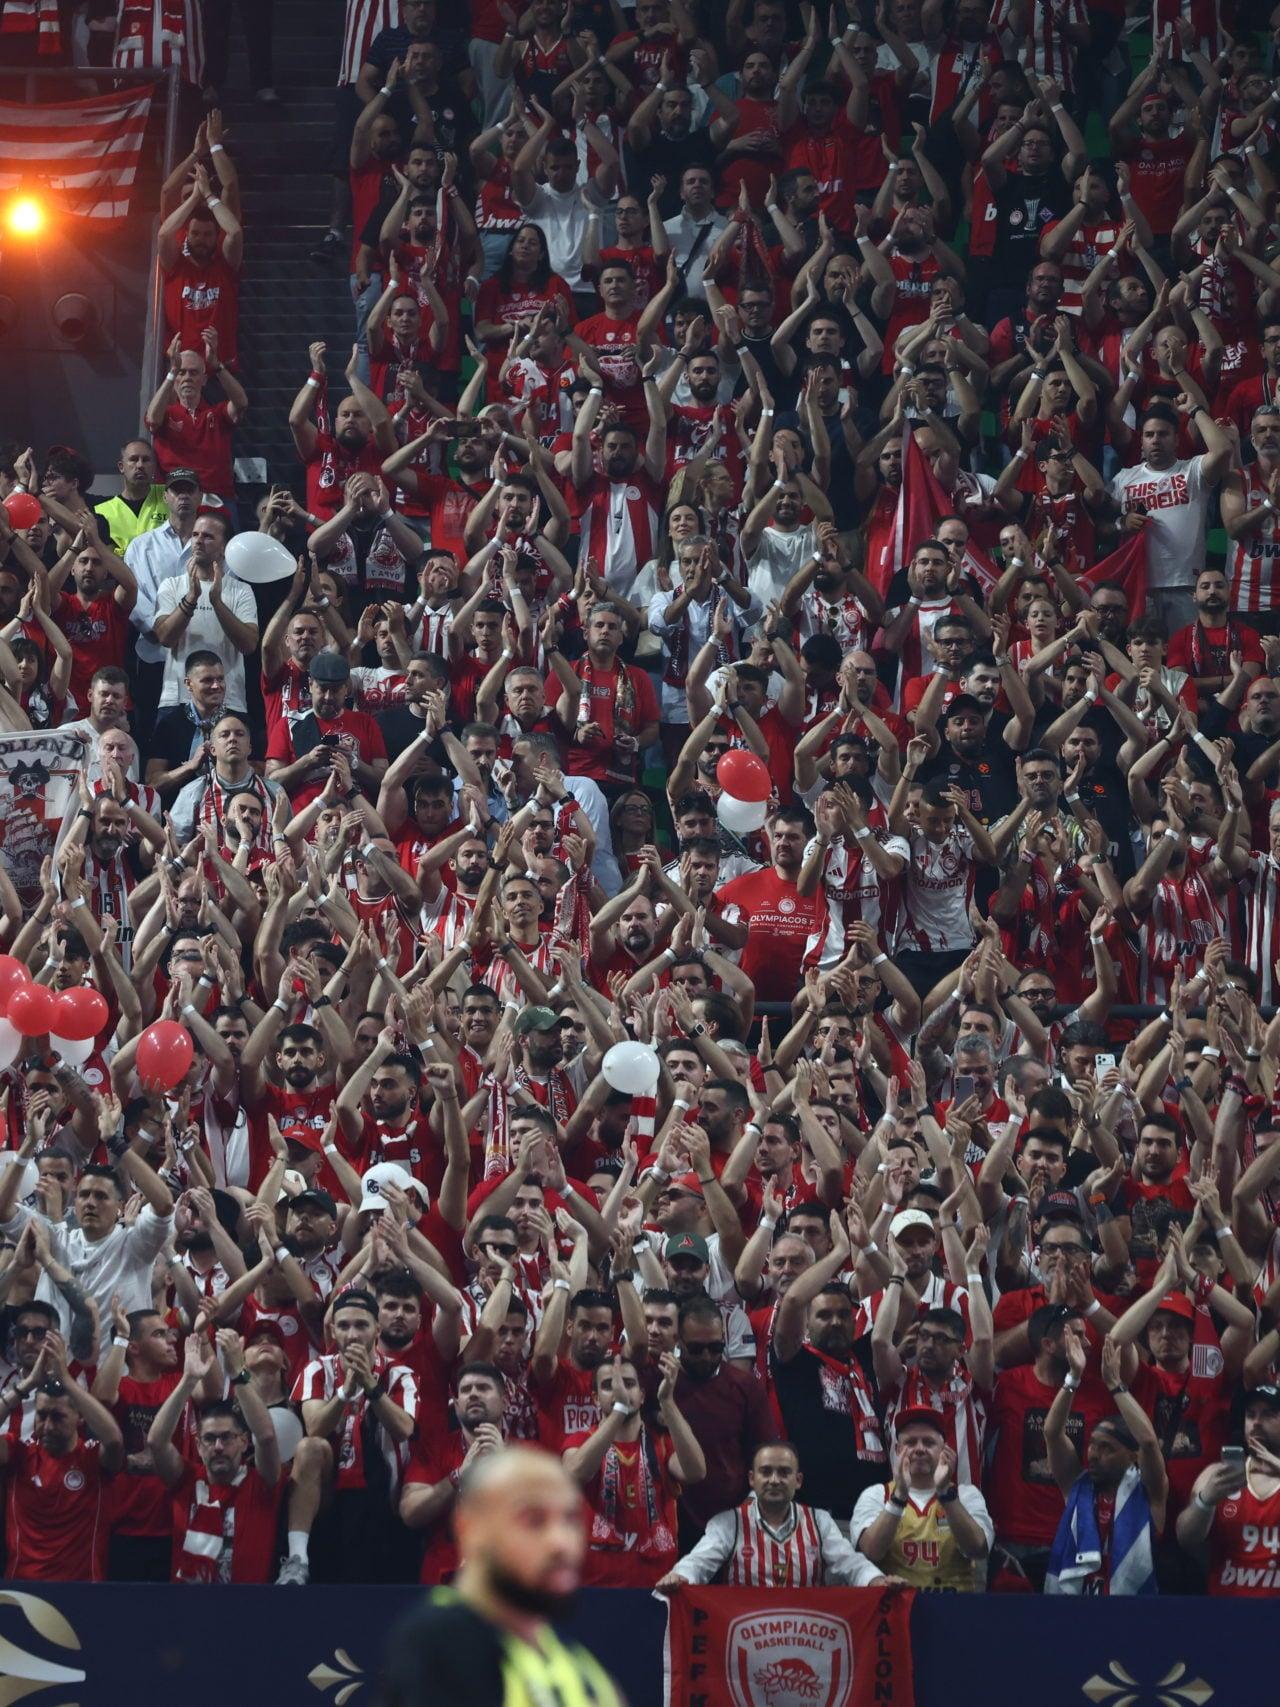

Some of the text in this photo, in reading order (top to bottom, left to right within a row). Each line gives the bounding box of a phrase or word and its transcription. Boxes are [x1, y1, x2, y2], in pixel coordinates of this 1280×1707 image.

[1125, 474, 1189, 508] THIS IS
[750, 914, 808, 926] OLYMPIACOS
[1244, 1524, 1279, 1554] 94
[903, 1540, 939, 1569] 94
[740, 1621, 839, 1641] OLYMPIACOS
[754, 1636, 825, 1652] BASKETBALL
[875, 1600, 894, 1707] SALON
